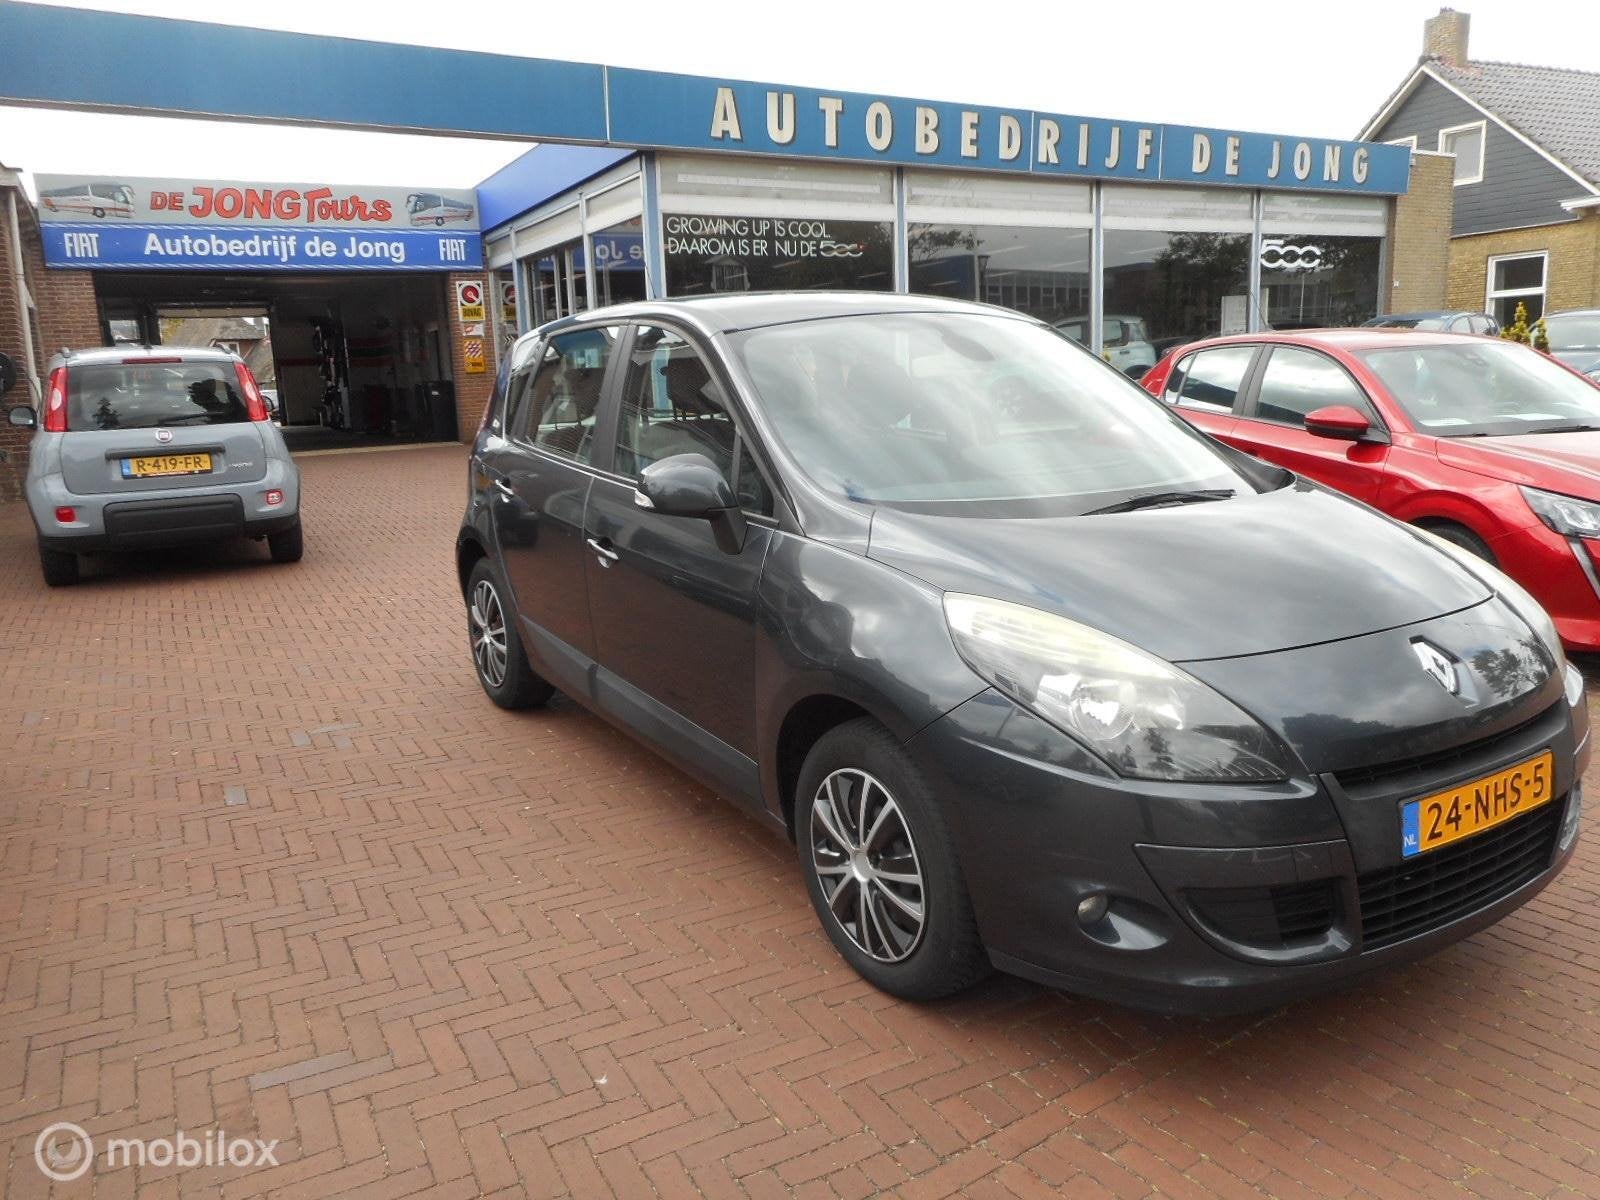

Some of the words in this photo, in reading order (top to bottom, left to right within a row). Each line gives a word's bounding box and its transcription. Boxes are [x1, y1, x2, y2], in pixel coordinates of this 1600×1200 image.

[710, 86, 1153, 171] AUTOBEDRIJF
[1191, 133, 1241, 176] DE
[1267, 140, 1369, 184] JONG
[149, 191, 185, 211] DE
[188, 186, 300, 220] JONG
[303, 187, 393, 223] Tours
[666, 216, 749, 237] GROWING
[752, 219, 770, 237] UP
[774, 219, 787, 237] IS
[788, 221, 832, 239] COOL.
[63, 232, 100, 258] FIAT
[144, 232, 297, 263] Autobedrijf
[304, 236, 337, 258] de
[343, 236, 406, 264] Jong
[438, 238, 467, 261] FIAT
[667, 236, 737, 256] DAAROM
[738, 239, 751, 257] IS
[753, 239, 769, 257] ER
[775, 240, 797, 257] NU
[800, 241, 818, 258] DE
[1260, 239, 1322, 268] 500
[136, 456, 203, 472] R-419-FR
[1427, 763, 1544, 841] 24-NHS-5
[1403, 835, 1417, 847] NL
